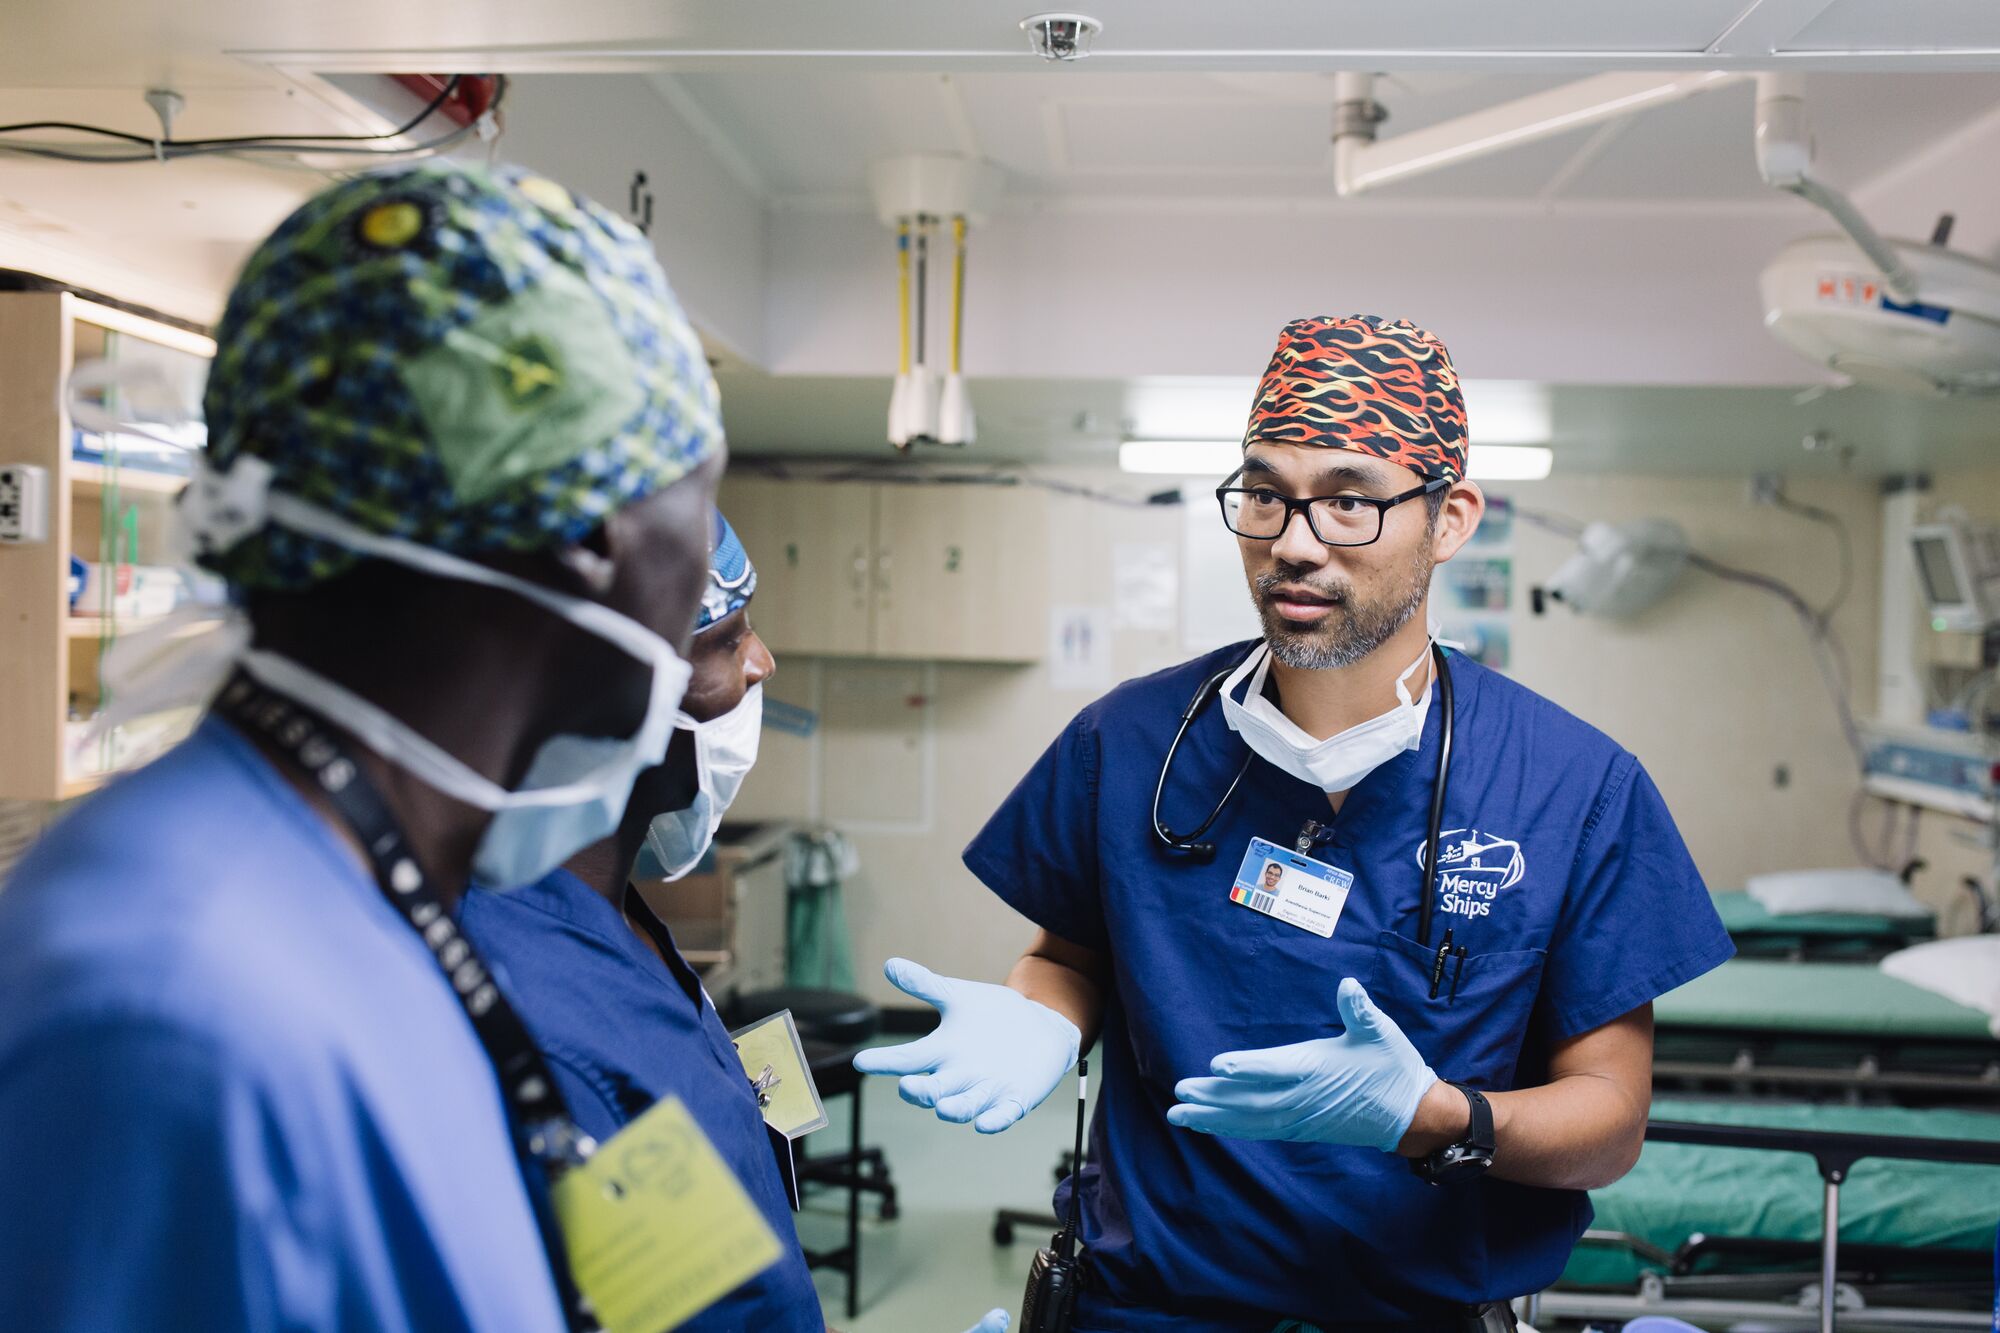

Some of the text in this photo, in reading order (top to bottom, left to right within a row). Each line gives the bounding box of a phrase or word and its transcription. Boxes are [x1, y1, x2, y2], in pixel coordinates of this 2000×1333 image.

[1323, 873, 1350, 889] CREW
[1439, 873, 1498, 899] Mercy
[1440, 893, 1491, 919] Ships
[411, 902, 499, 1016] JESUS
